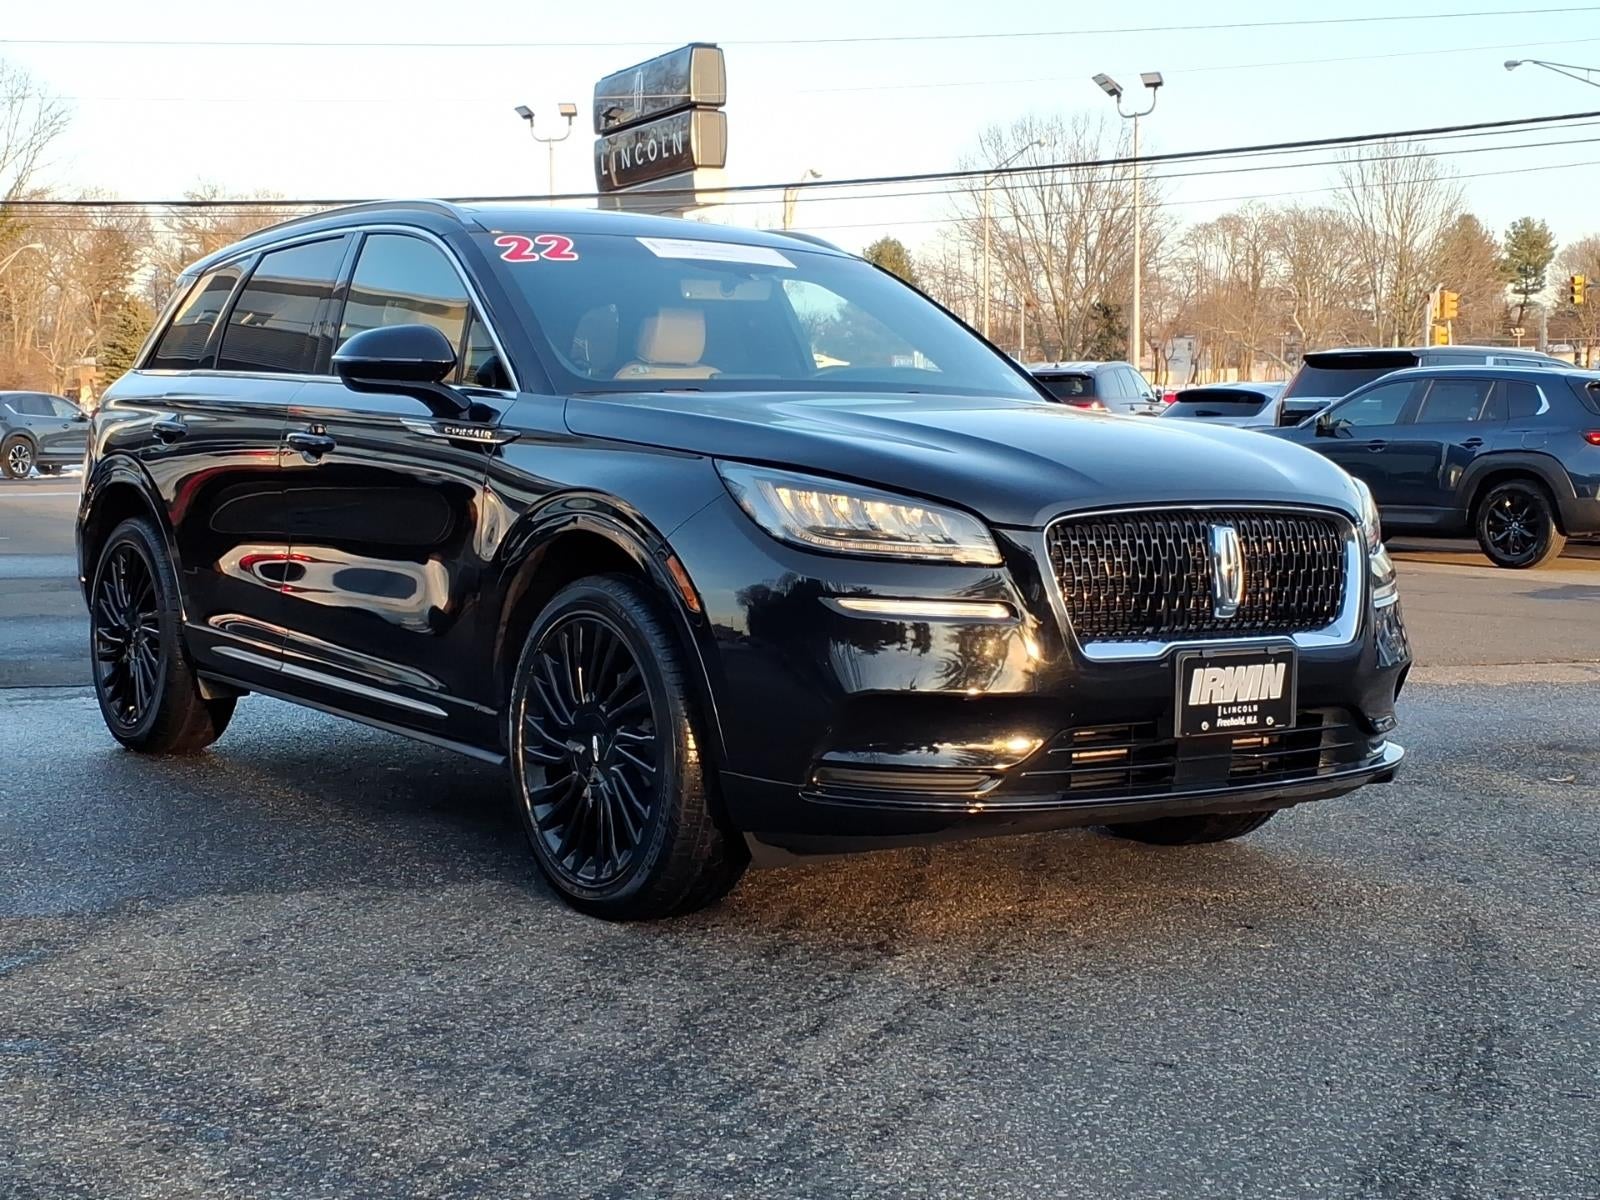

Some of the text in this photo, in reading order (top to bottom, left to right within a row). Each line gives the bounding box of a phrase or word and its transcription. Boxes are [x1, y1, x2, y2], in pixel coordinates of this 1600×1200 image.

[600, 131, 683, 176] LINCOLN
[494, 234, 579, 263] 22
[444, 426, 492, 439] CORSAIR
[1188, 662, 1286, 706] IRWIN
[1223, 704, 1258, 715] LINCOLN
